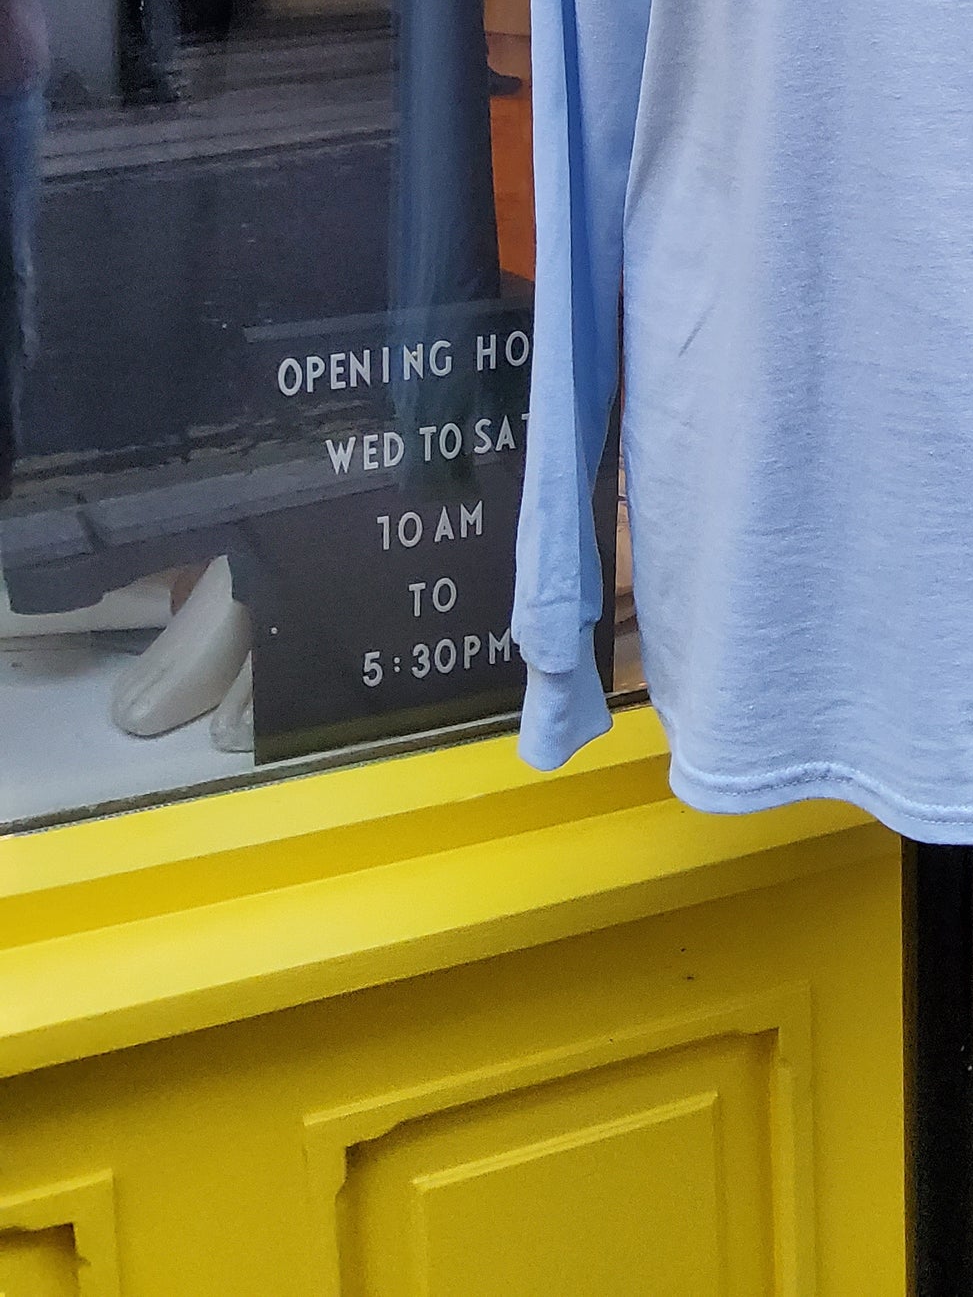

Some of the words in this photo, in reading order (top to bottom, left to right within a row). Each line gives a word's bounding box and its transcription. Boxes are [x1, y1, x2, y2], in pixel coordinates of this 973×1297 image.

[277, 340, 453, 397] OPENING
[476, 330, 530, 371] HO
[326, 433, 405, 475] WED
[419, 422, 463, 462] TO
[408, 577, 458, 617] TO
